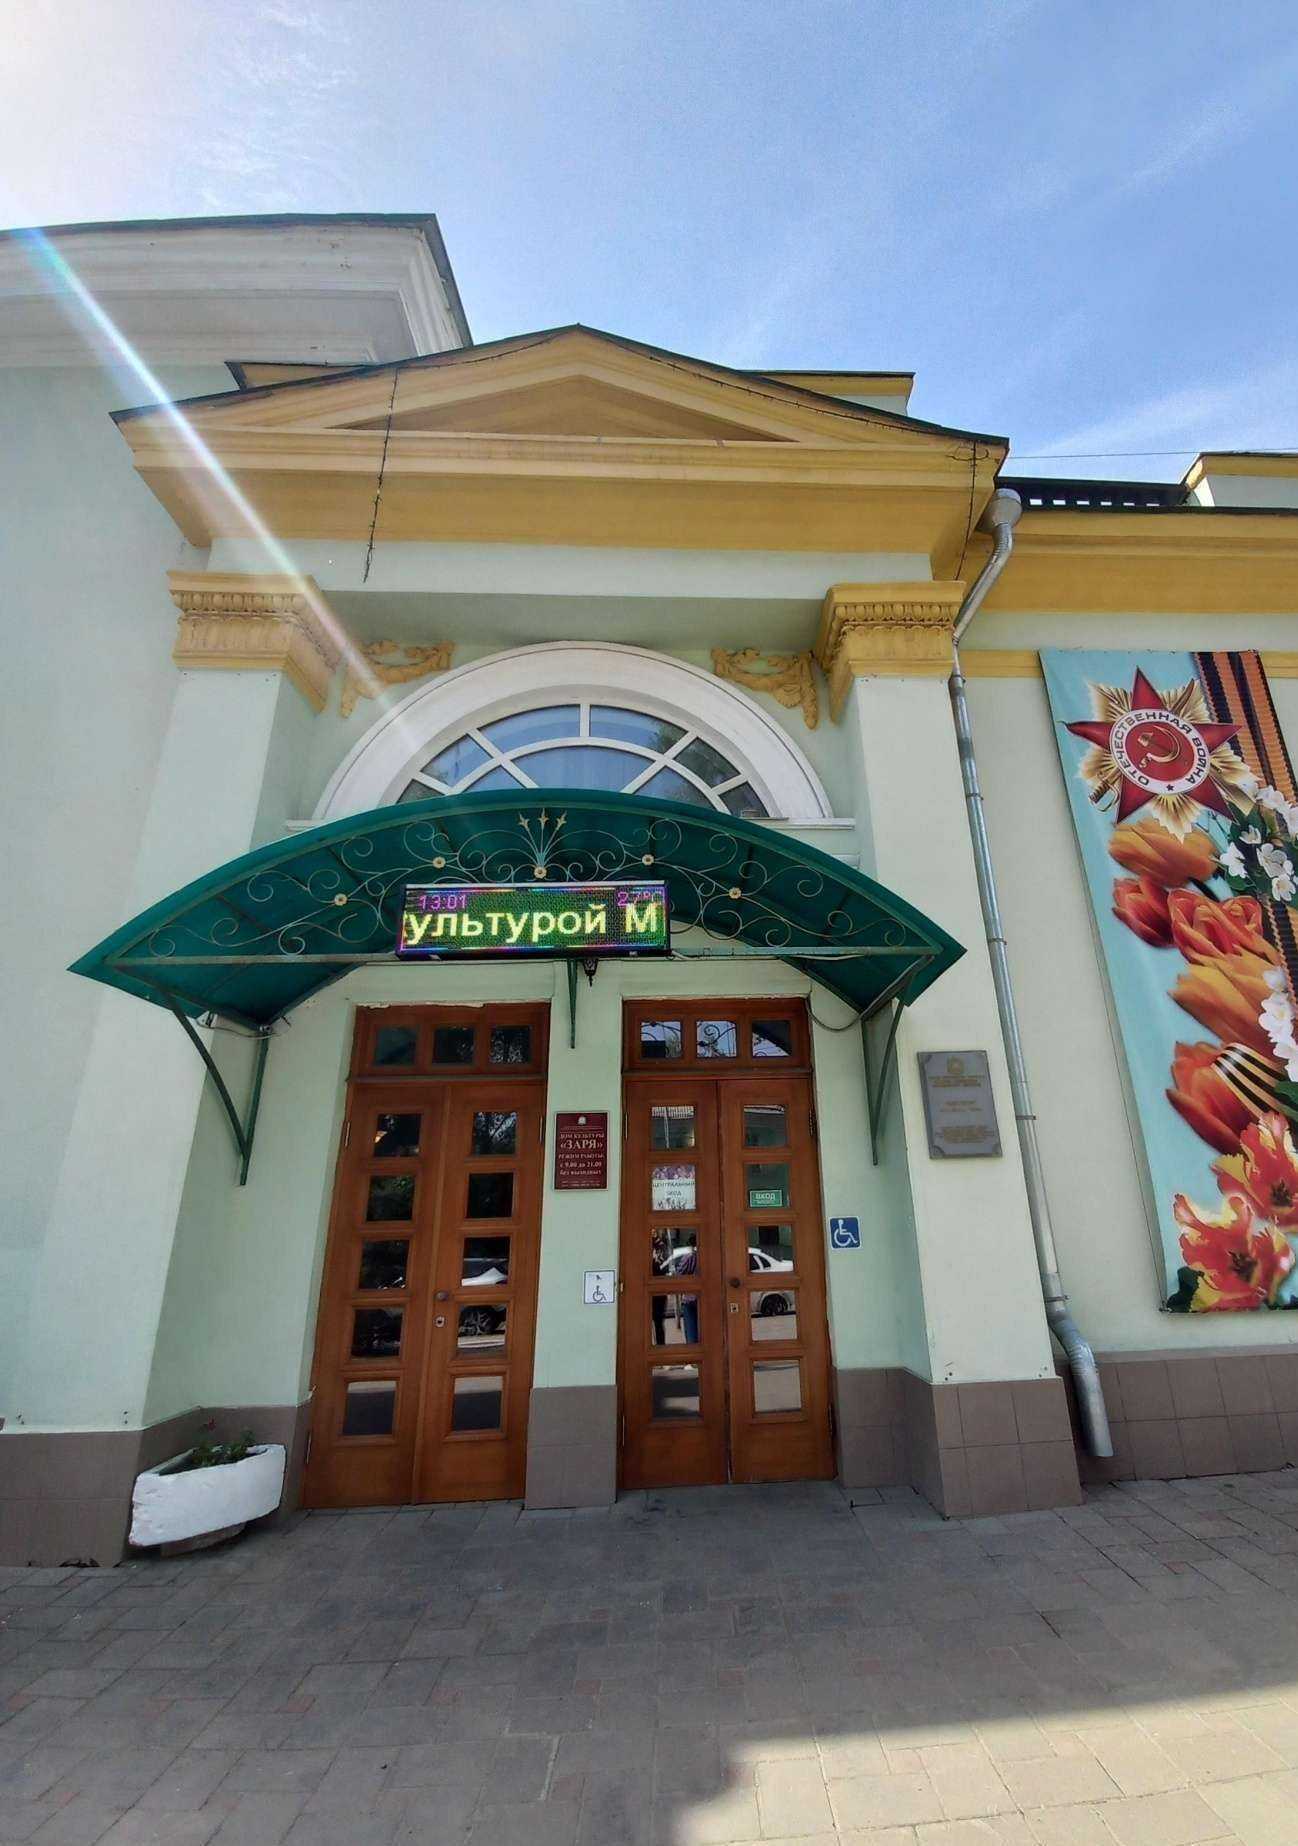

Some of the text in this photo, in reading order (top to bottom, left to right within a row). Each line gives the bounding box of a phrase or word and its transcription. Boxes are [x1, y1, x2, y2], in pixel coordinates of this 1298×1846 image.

[1113, 711, 1192, 786] ОТЕЧЕСТВЕННАЯ
[418, 894, 467, 910] 13:01
[560, 1139, 603, 1150] «ЗАРЯ»
